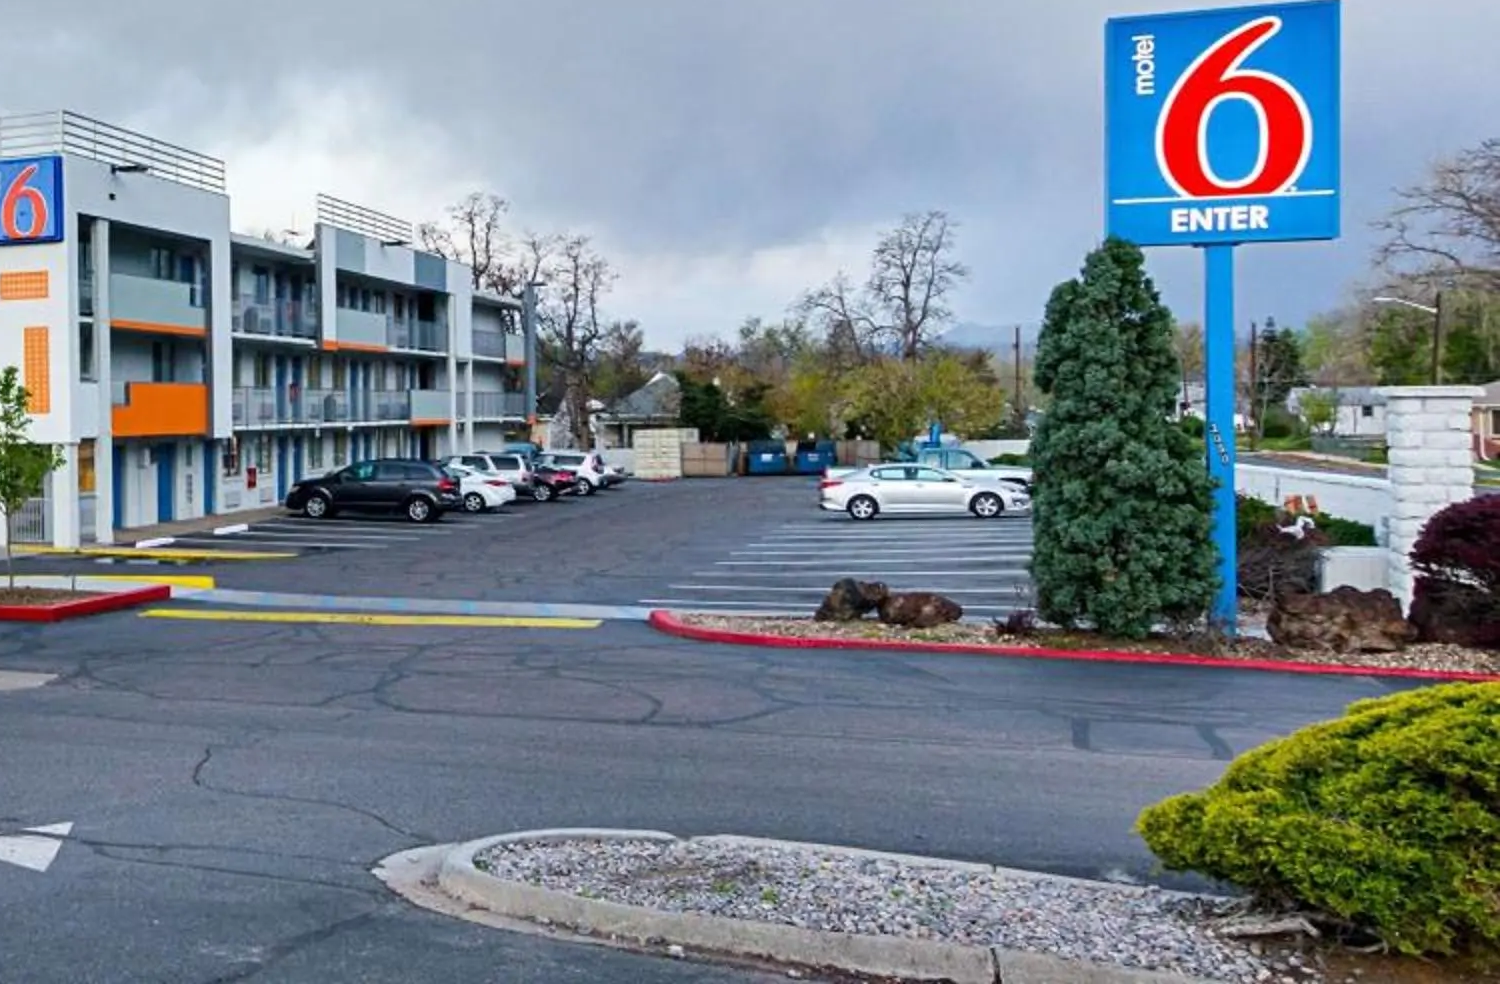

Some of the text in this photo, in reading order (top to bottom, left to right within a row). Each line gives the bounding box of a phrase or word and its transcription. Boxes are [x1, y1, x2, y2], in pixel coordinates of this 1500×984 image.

[1132, 33, 1155, 96] motel
[1155, 15, 1313, 198] 6
[1, 164, 48, 240] 6
[1171, 205, 1269, 232] ENTER
